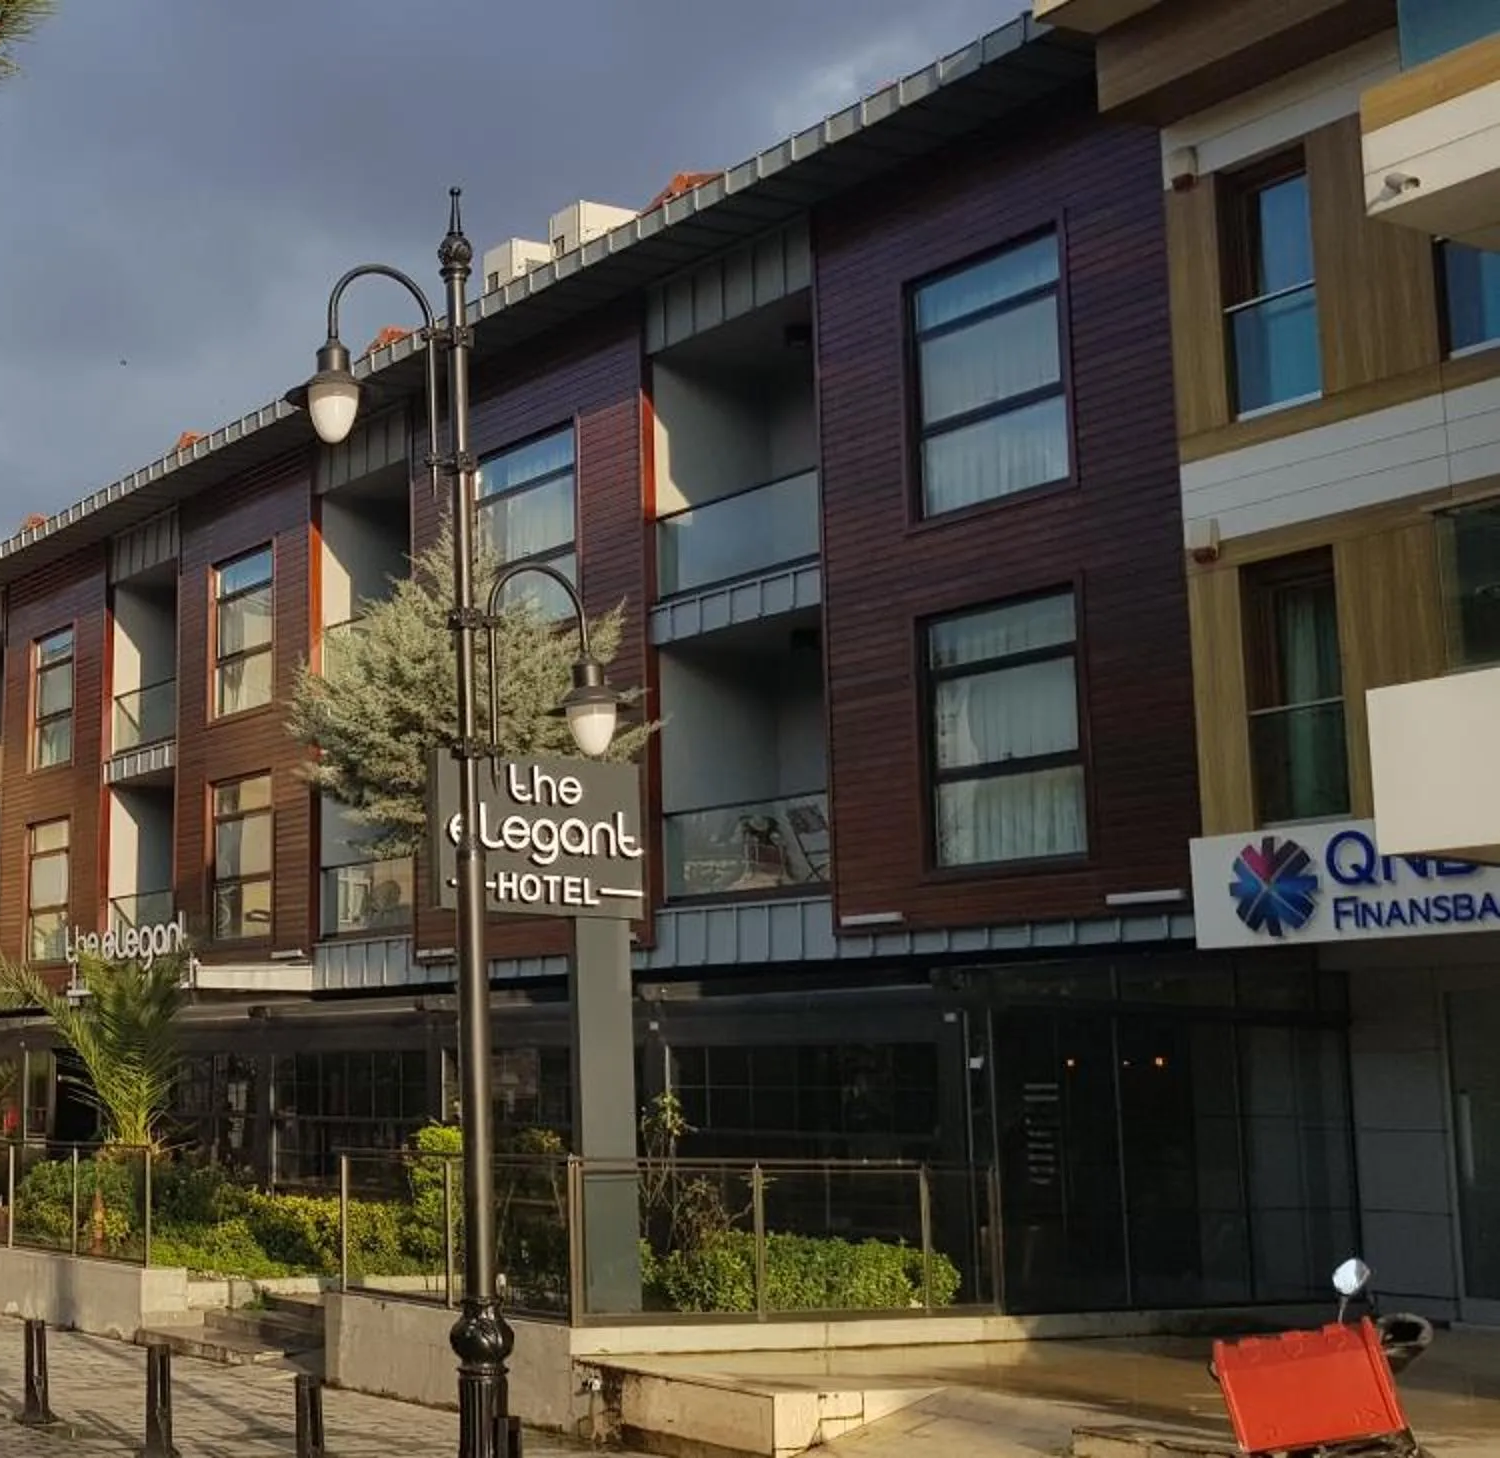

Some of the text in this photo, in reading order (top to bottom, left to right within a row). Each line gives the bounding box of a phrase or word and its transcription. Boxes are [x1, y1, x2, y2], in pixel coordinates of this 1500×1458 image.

[510, 763, 582, 805] the
[499, 871, 600, 905] HOTEL
[65, 911, 188, 971] the elegant
